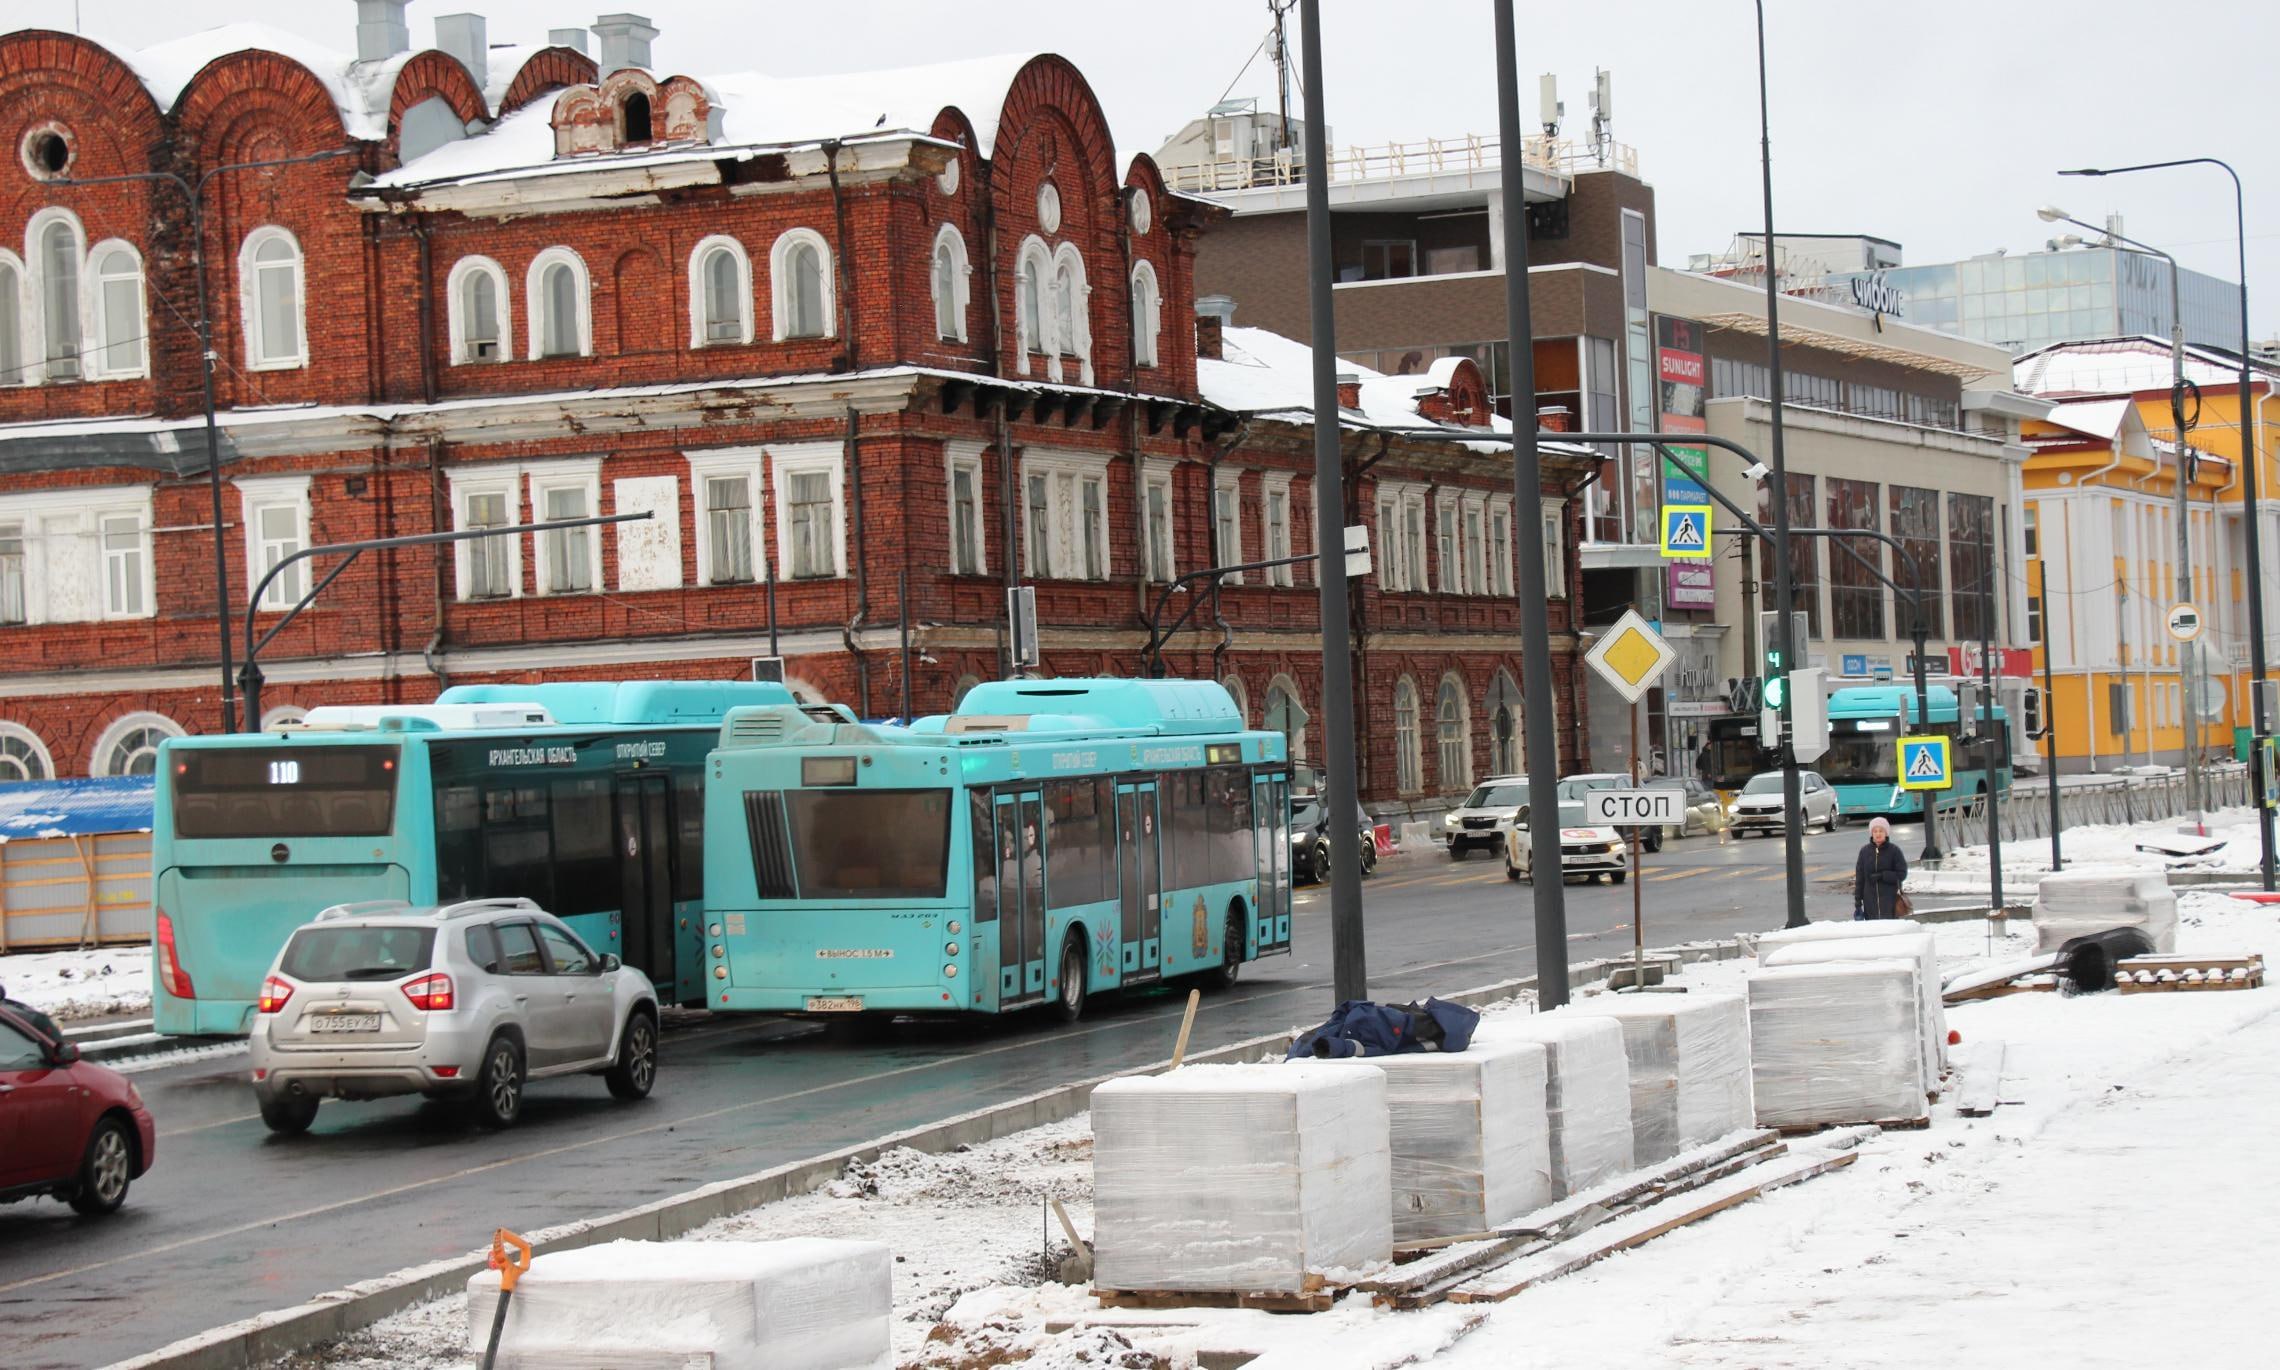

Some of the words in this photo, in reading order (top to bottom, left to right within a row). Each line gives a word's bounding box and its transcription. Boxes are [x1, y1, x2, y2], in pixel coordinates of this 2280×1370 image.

[1851, 271, 1904, 317] Чиббис
[1662, 356, 1701, 377] SUNLIGHT
[1768, 651, 1780, 668] 4
[489, 748, 545, 766] АРХАНГЕЛЬСКАЯ
[547, 746, 577, 763] ОБЛАСТЬ
[649, 741, 666, 757] СЕВЕР
[269, 761, 299, 784] 110
[1601, 796, 1670, 817] СТОП
